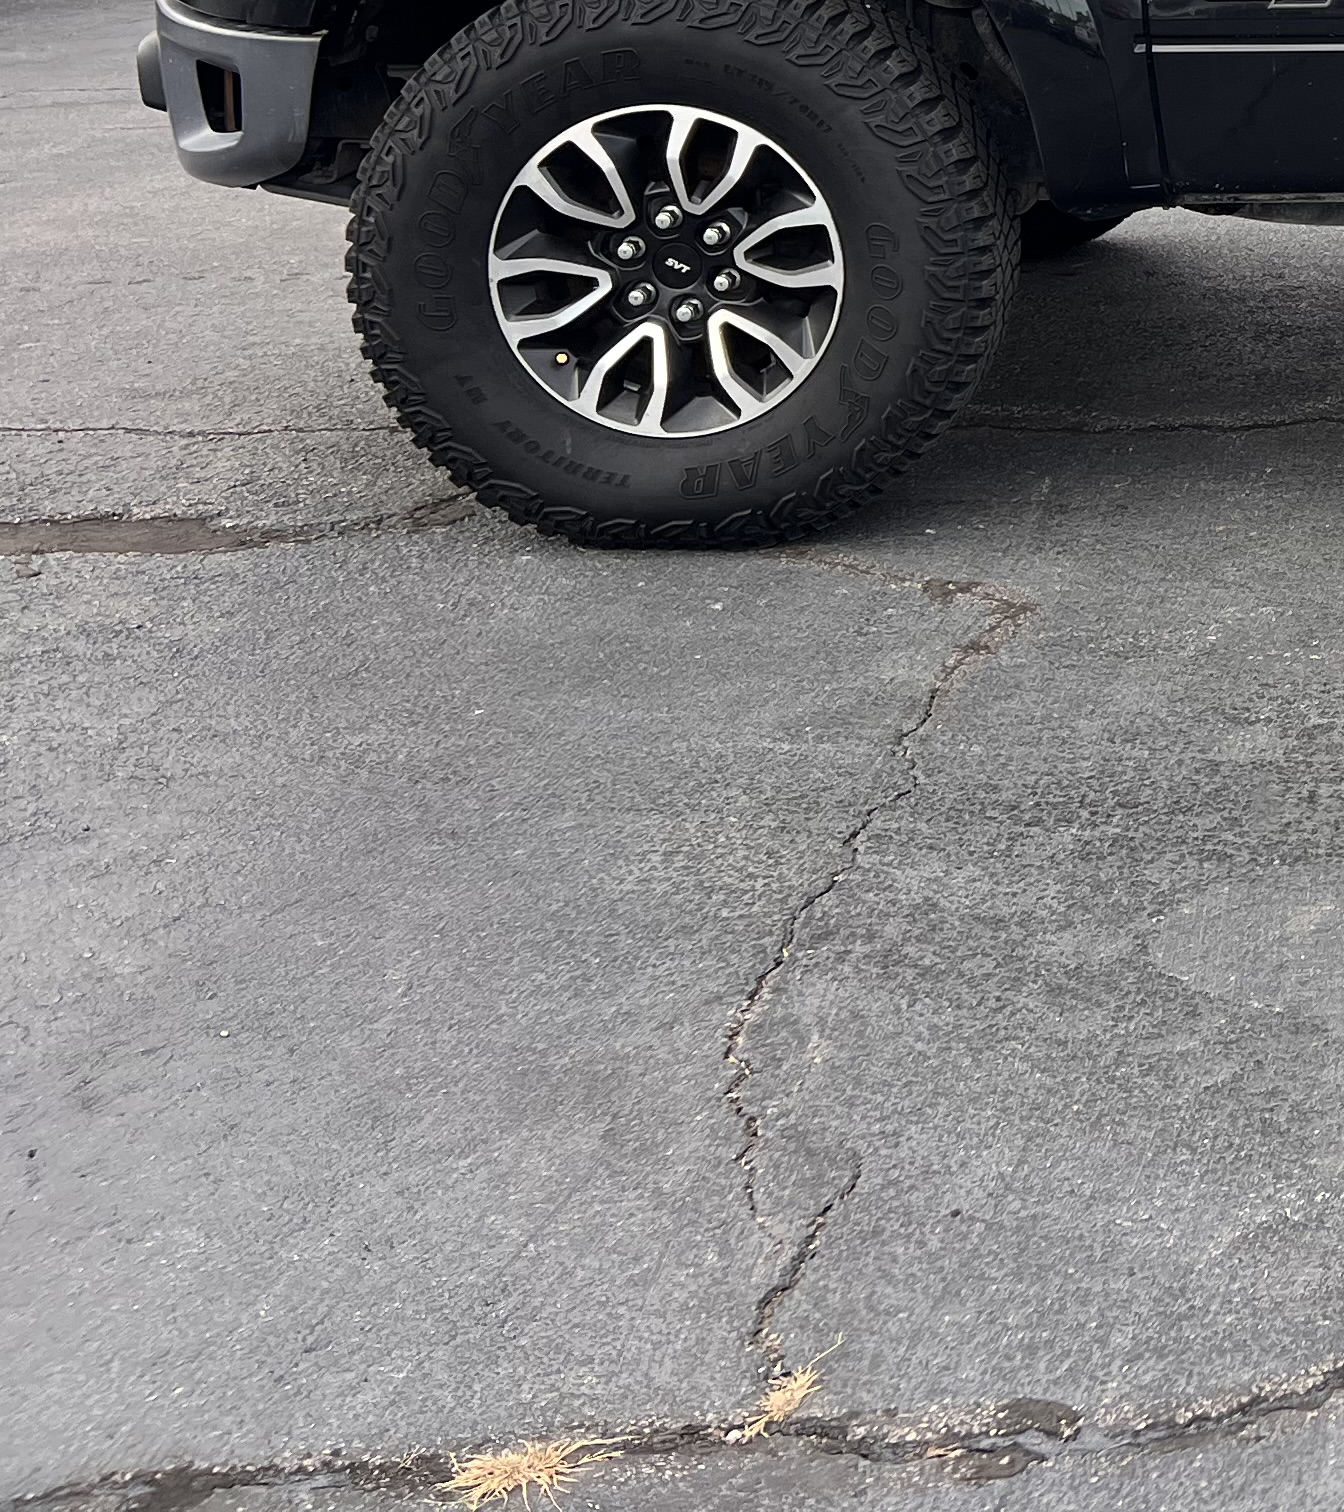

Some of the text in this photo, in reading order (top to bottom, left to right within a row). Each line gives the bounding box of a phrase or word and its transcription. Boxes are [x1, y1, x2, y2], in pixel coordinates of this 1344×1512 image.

[412, 46, 643, 333] GOODYEAR
[664, 257, 691, 274] SVT
[679, 221, 905, 500] GOODYEAR
[489, 419, 632, 489] TERRITORY
